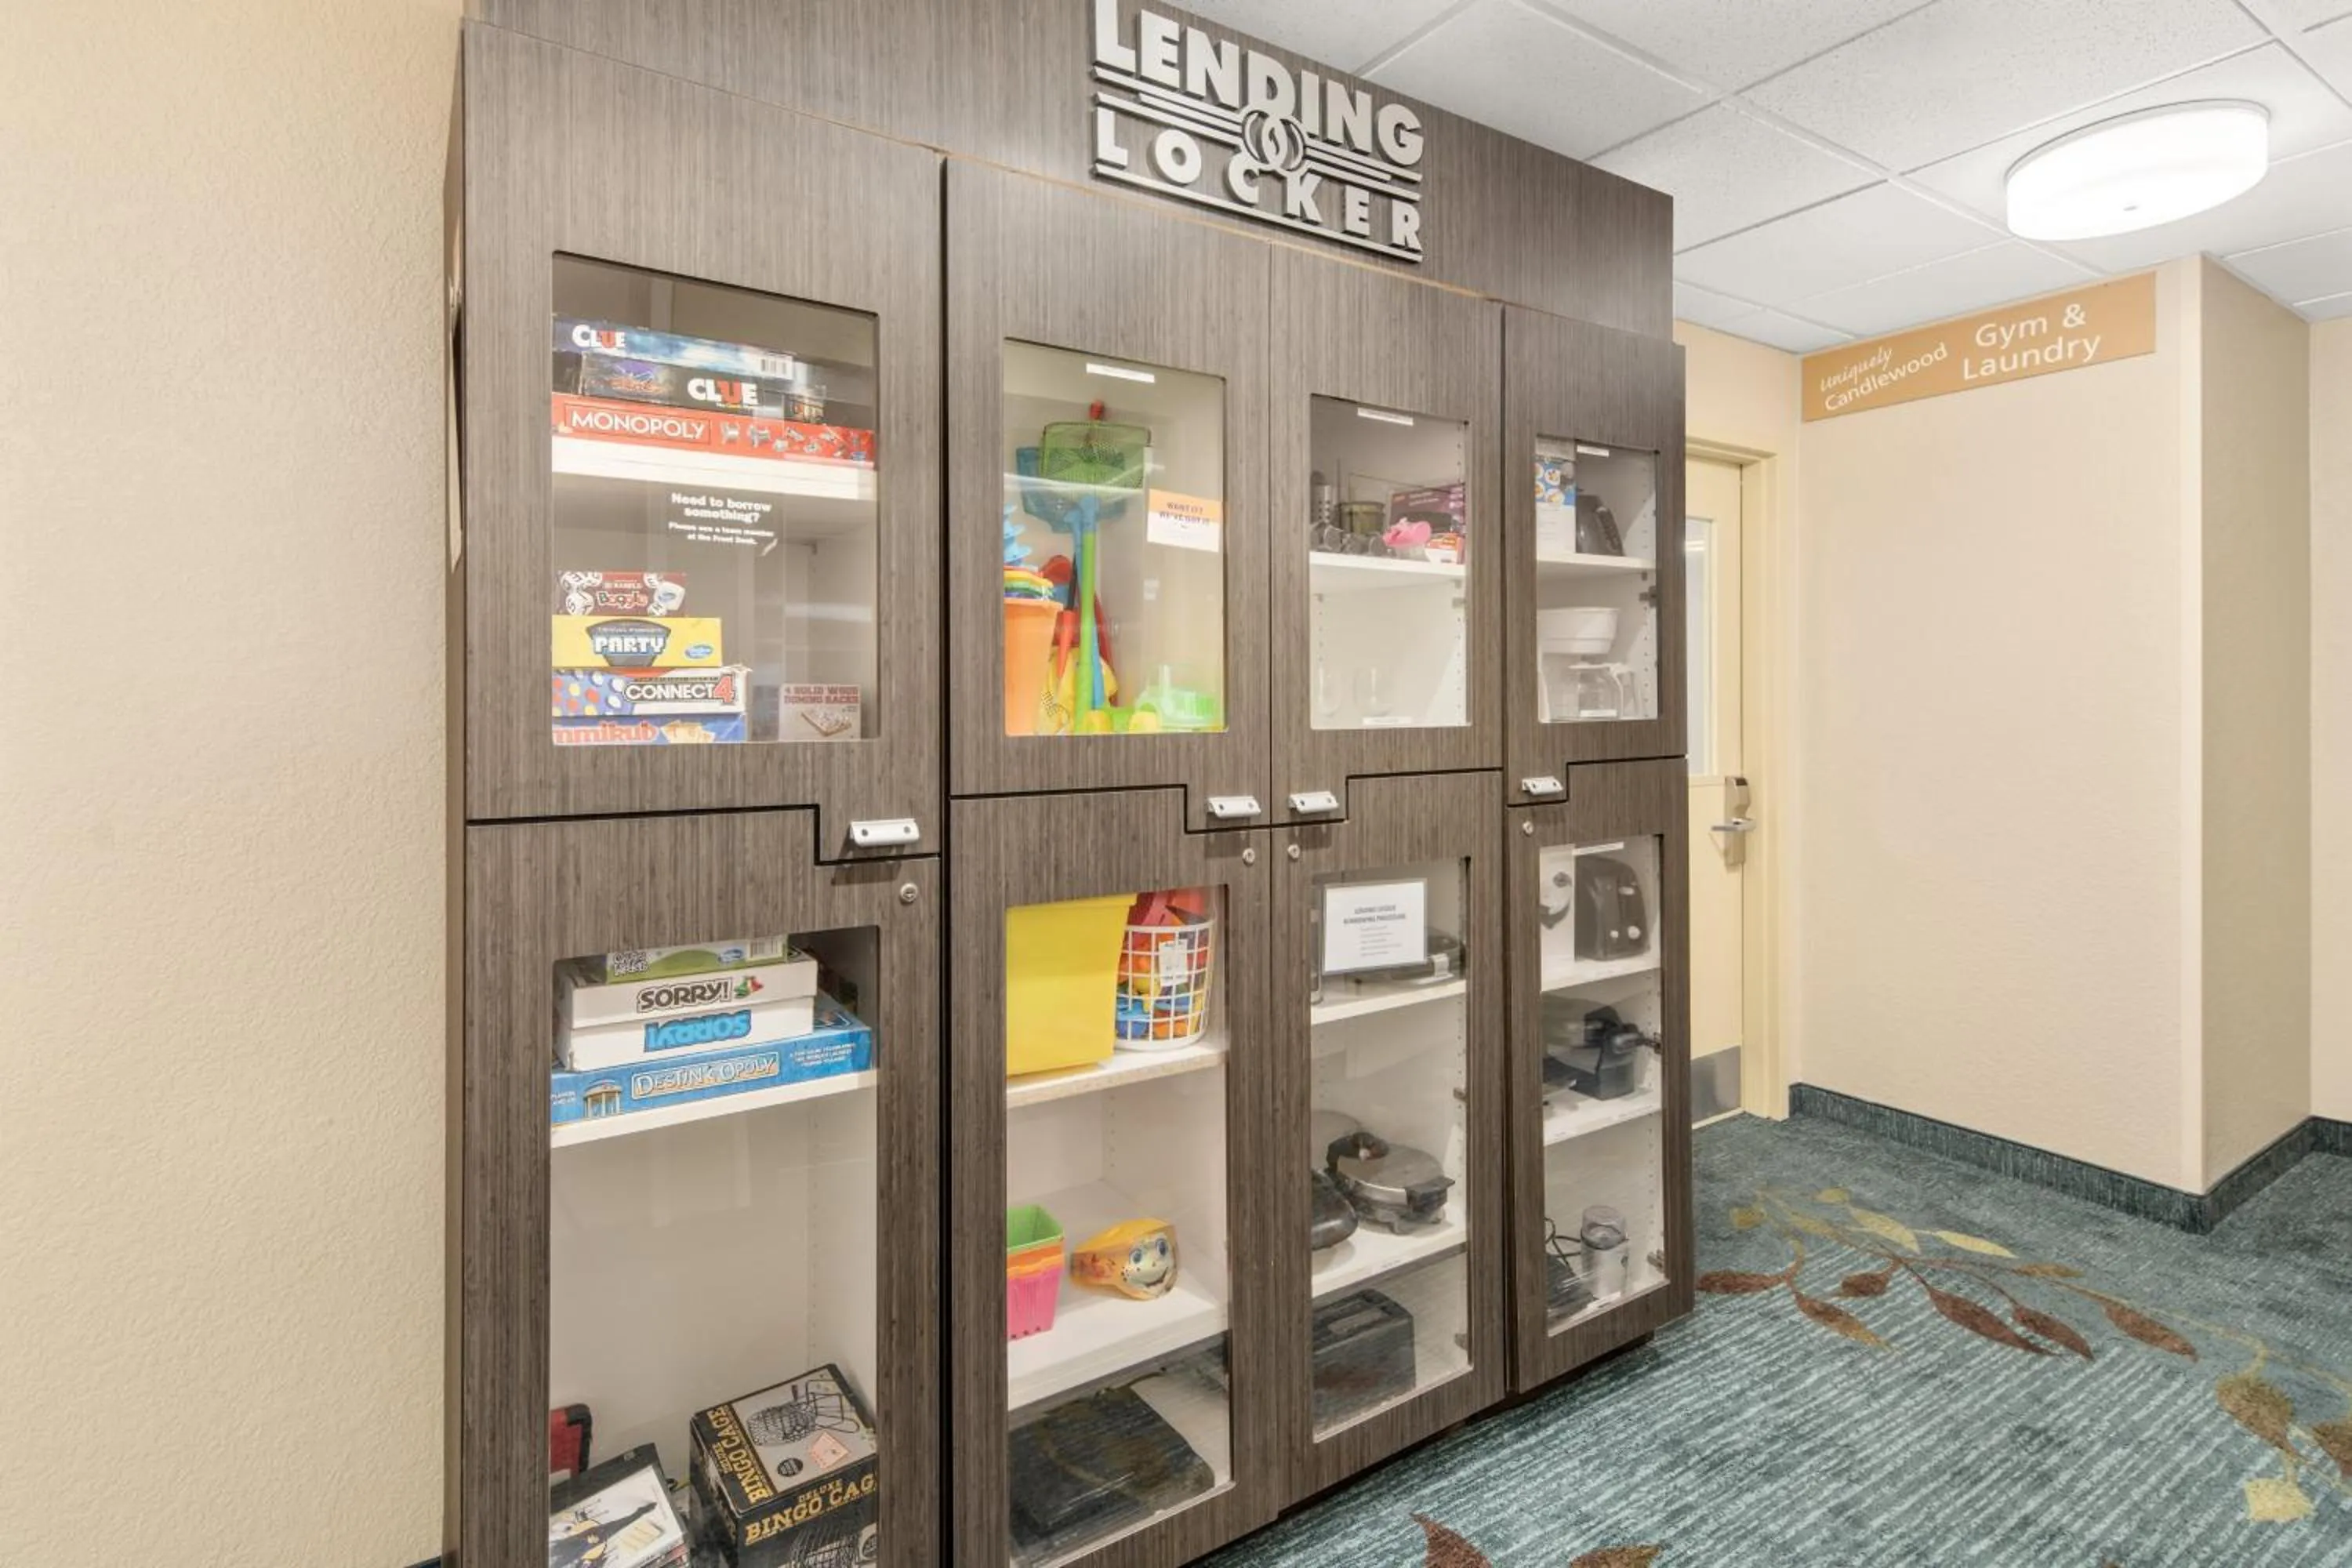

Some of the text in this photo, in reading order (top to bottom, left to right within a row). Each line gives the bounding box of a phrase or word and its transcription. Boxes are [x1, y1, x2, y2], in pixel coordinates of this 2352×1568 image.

[1095, 0, 1424, 165] LENDING
[1096, 106, 1422, 250] LOCKER
[572, 324, 626, 349] CLUE
[1975, 303, 2087, 350] Gym &
[1820, 345, 1892, 391] uniquely
[1963, 335, 2101, 380] Laundry
[687, 377, 759, 406] CLUE
[1824, 342, 1948, 411] Candlewood
[572, 410, 705, 439] MONOPOLY
[671, 492, 772, 512] Need to borrow
[684, 507, 760, 524] something?
[594, 634, 664, 653] PARTY
[626, 675, 735, 703] CONNECT 4
[641, 981, 729, 1011] SORRY!
[706, 1404, 771, 1504] BINGO CAGE
[746, 1472, 877, 1541] BINGO CAG
